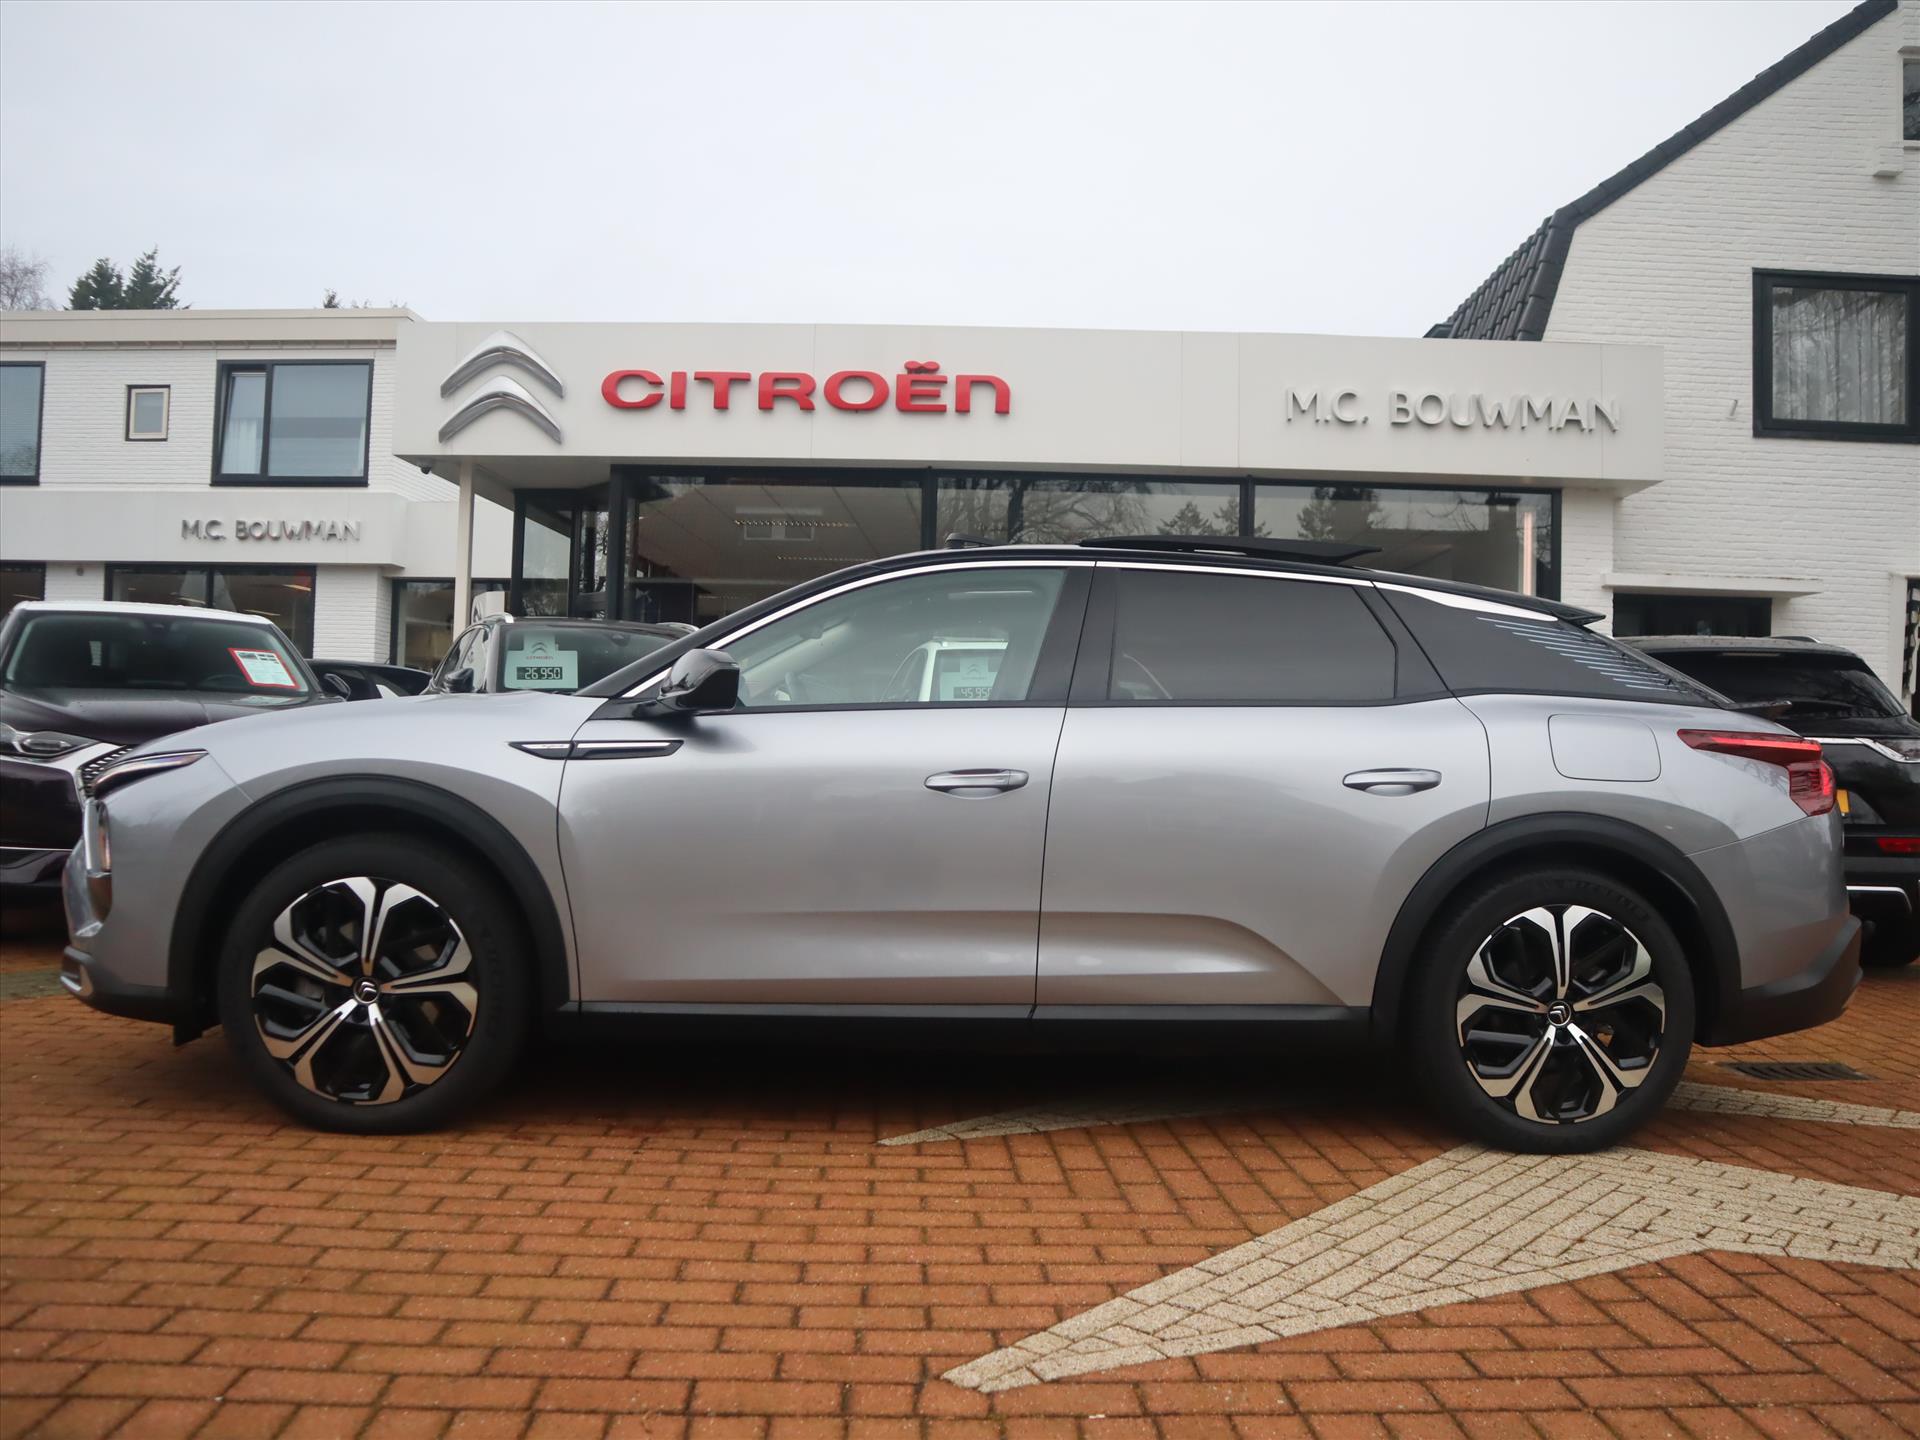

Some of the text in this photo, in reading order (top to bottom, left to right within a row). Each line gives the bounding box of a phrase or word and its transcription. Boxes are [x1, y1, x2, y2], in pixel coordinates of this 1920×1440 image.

[1286, 388, 1620, 433] M.C. BOUWMAN
[235, 519, 361, 542] BOUWMAN
